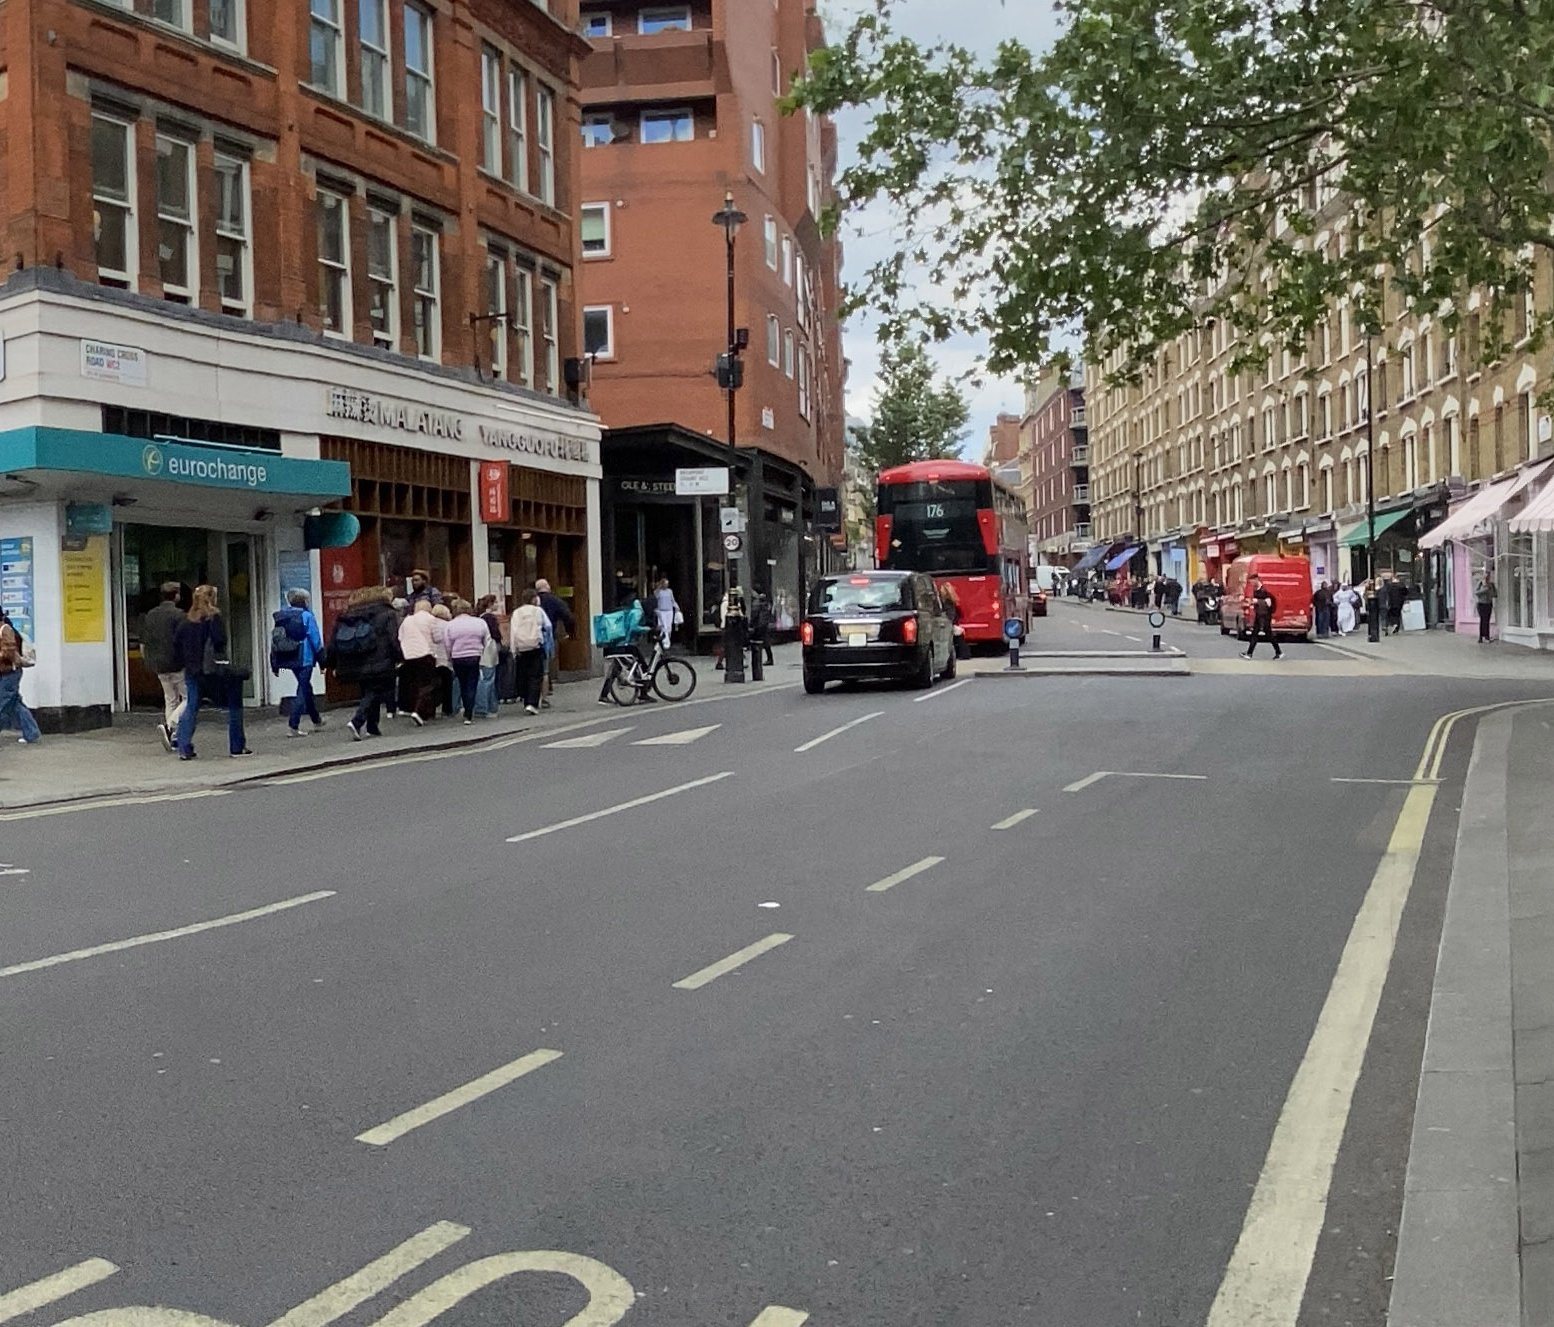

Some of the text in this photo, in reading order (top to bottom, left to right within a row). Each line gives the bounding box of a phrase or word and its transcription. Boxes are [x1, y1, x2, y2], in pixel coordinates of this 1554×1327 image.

[85, 343, 139, 362] CHARING CROSS
[86, 355, 105, 368] ROAD
[168, 457, 267, 487] eurochange
[926, 503, 944, 518] 176
[725, 538, 738, 547] 20
